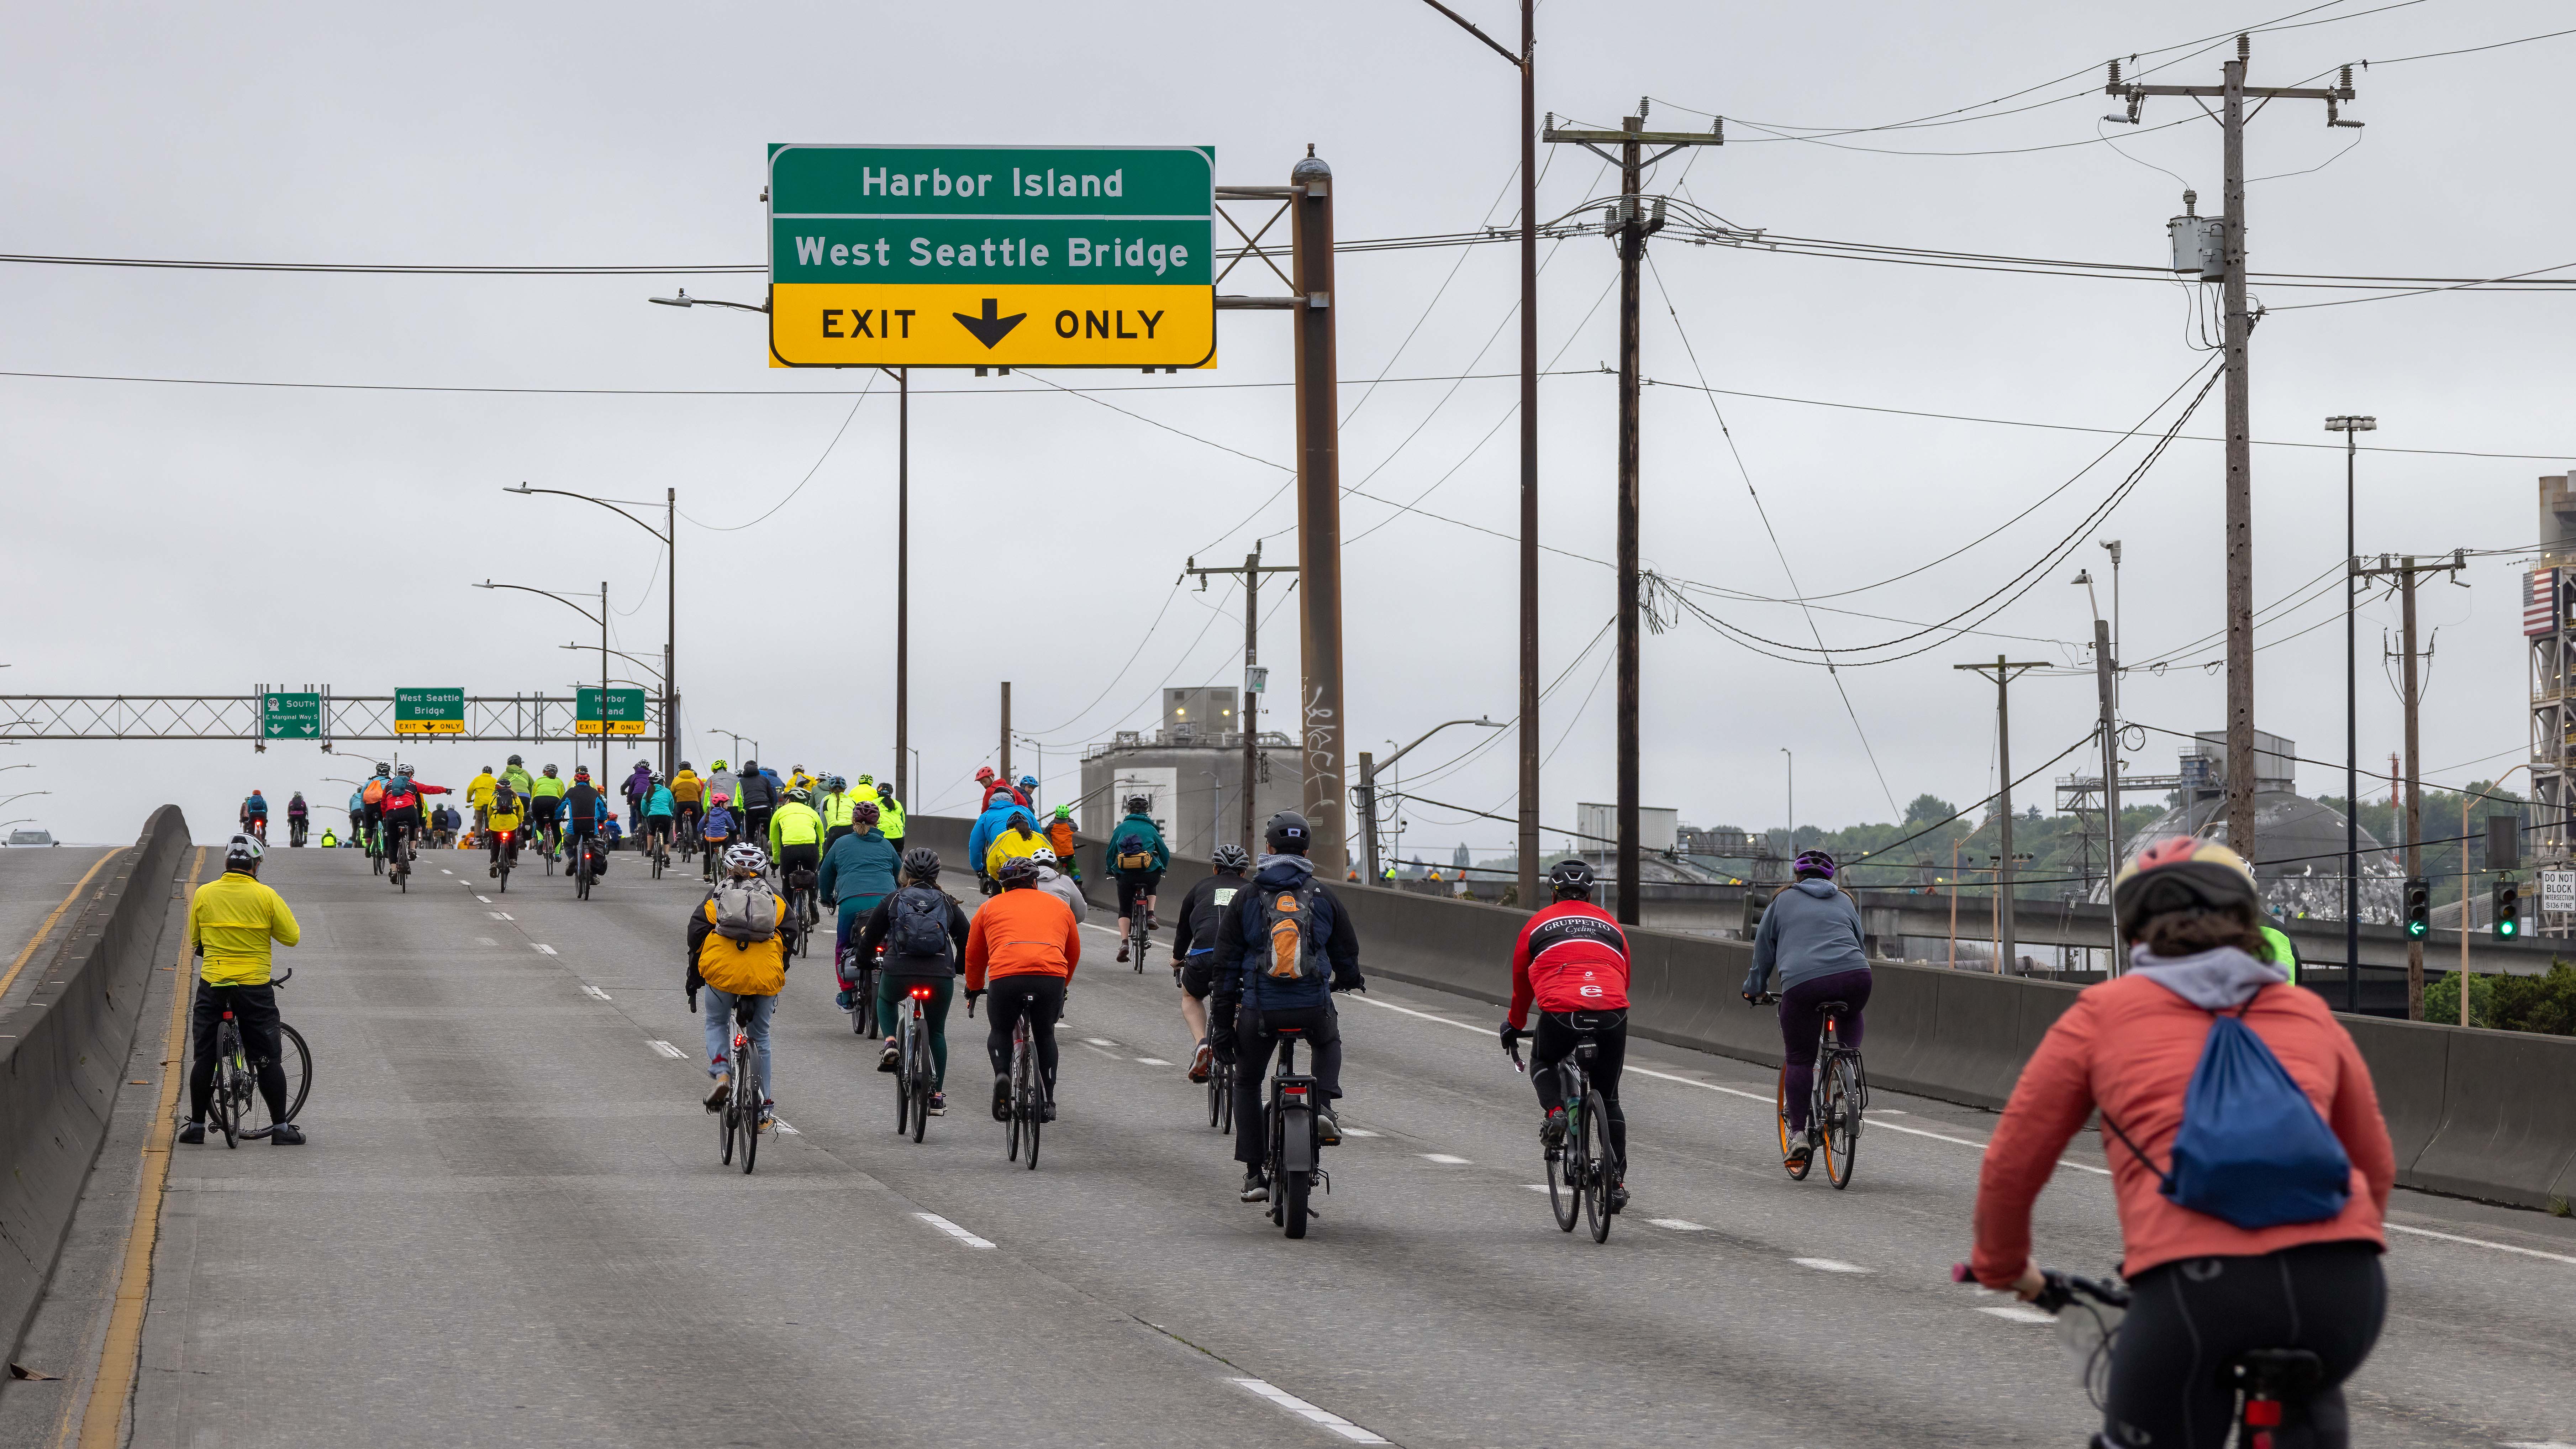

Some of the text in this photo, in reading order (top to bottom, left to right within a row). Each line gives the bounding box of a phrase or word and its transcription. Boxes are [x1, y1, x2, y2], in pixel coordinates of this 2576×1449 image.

[864, 167, 1122, 197] Harbor Island
[796, 237, 1188, 276] West Seattle Bridge
[823, 310, 1164, 338] EXIT ONLY
[415, 707, 444, 716] Bridge
[2547, 885, 2571, 893] BLOCK
[1545, 919, 1610, 931] GRUPPETTO
[1566, 926, 1596, 935] Cycling
